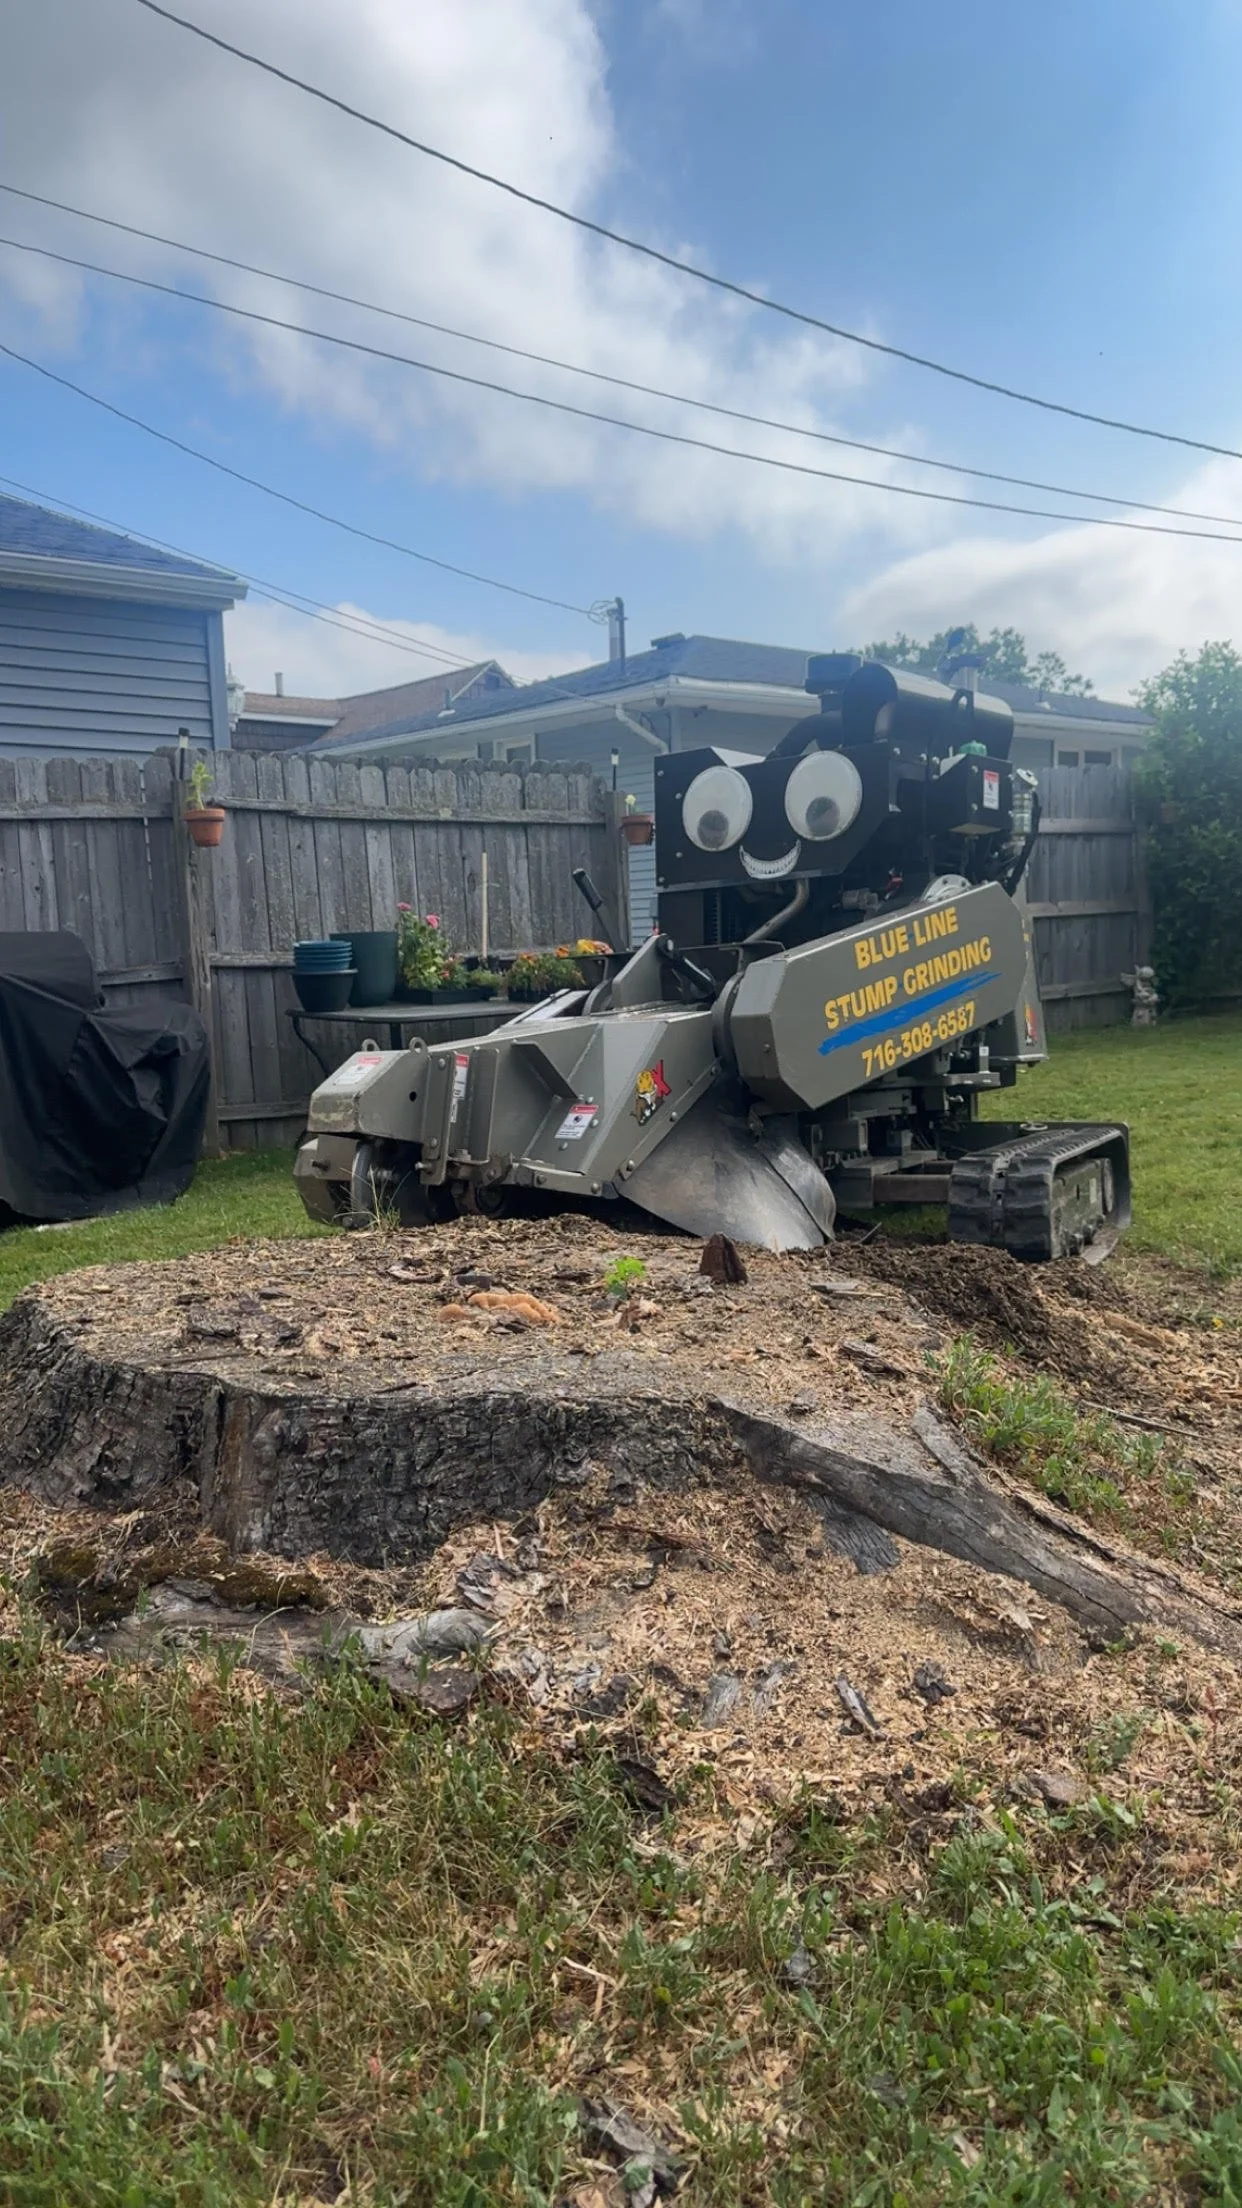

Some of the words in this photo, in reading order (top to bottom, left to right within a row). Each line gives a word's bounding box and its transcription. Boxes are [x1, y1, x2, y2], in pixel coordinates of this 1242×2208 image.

[854, 925, 910, 969] BLUE
[913, 907, 958, 947] LINE
[824, 976, 898, 1030] STUMP
[902, 937, 992, 995] GRINDING
[861, 1001, 976, 1076] 716-308-6587
